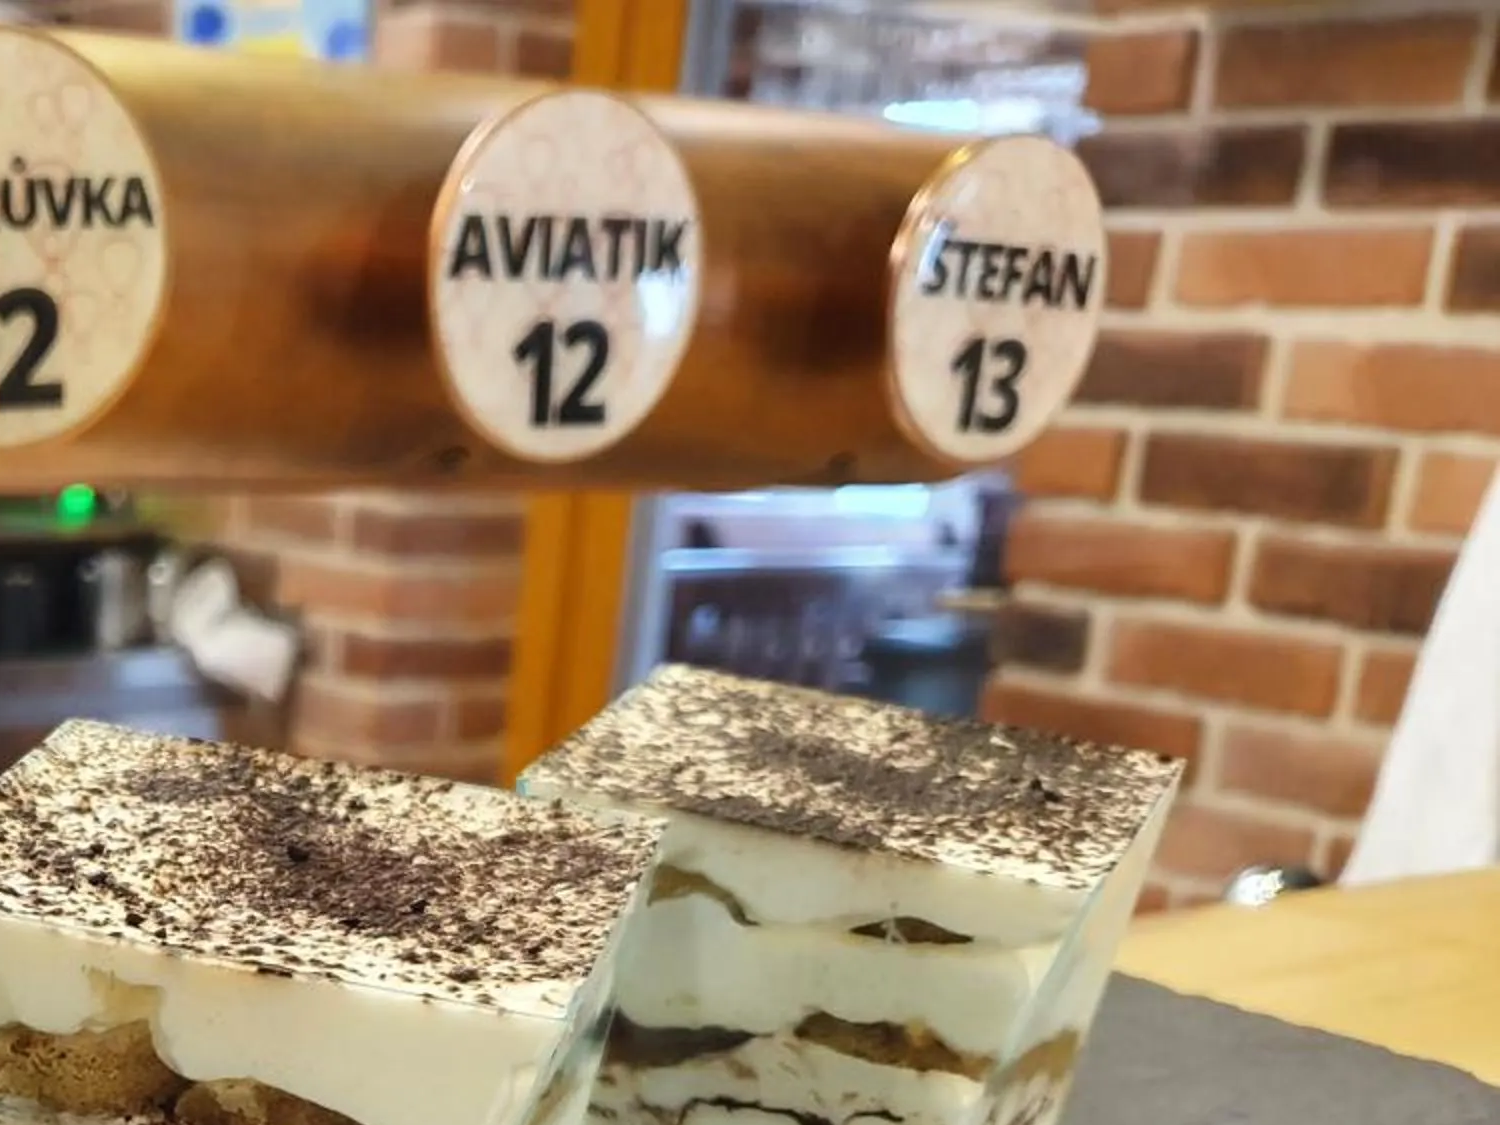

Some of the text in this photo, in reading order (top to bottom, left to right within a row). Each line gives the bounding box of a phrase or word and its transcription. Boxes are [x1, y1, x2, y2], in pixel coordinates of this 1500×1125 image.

[450, 214, 688, 280] AVIATIK
[513, 319, 609, 427] 12
[950, 337, 1029, 435] 13
